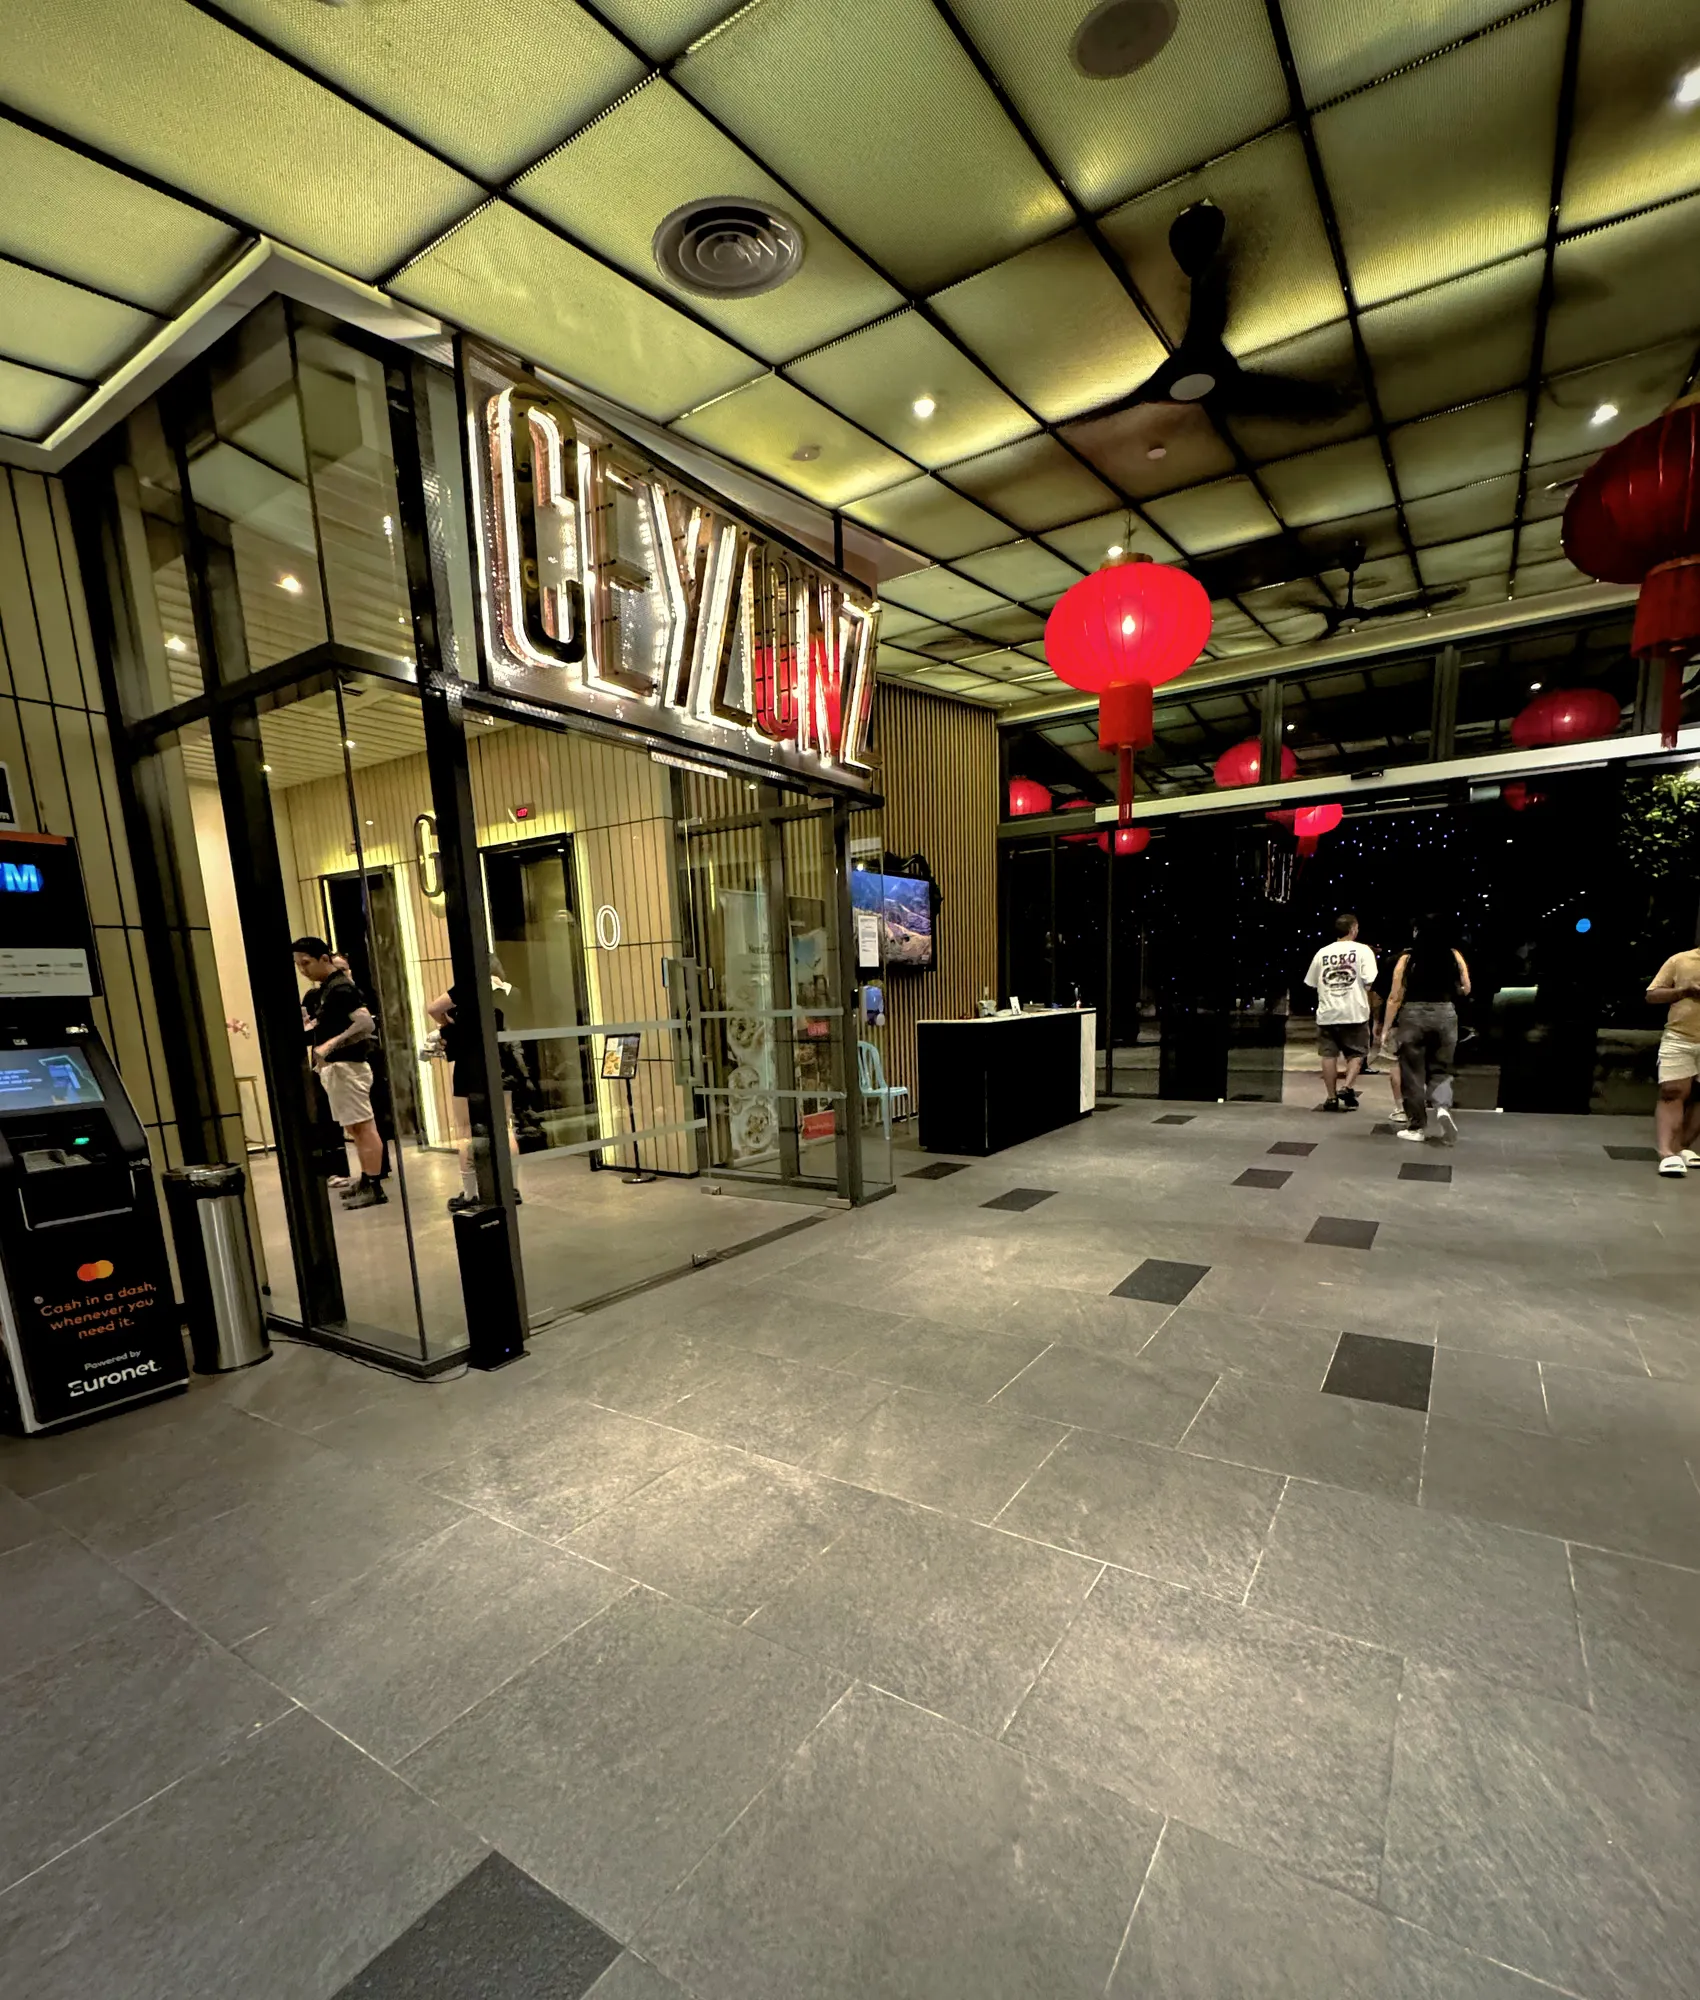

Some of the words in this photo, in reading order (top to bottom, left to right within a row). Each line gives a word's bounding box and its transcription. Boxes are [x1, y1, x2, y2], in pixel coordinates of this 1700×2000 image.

[40, 1299, 82, 1316] Cash
[86, 1296, 100, 1306] in
[104, 1293, 114, 1301] a
[118, 1281, 157, 1298] dash,
[50, 1304, 124, 1330] whenever
[127, 1298, 154, 1312] you
[78, 1321, 115, 1339] need
[119, 1317, 135, 1328] it.
[84, 1353, 128, 1371] Powered
[130, 1350, 142, 1359] by
